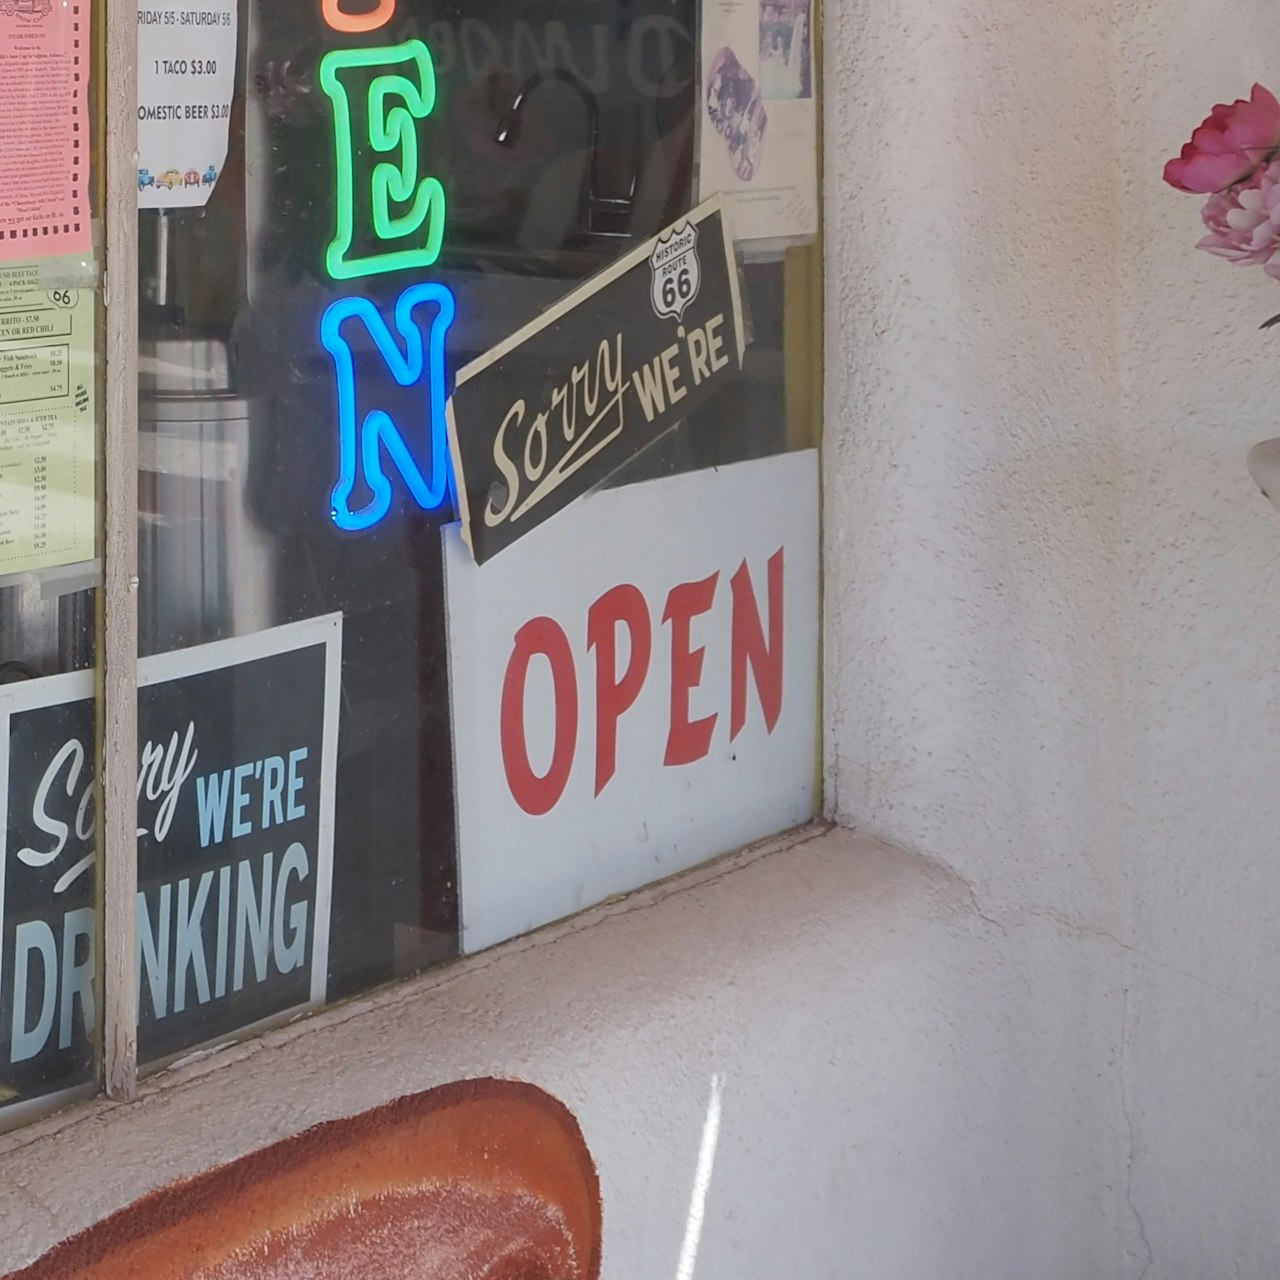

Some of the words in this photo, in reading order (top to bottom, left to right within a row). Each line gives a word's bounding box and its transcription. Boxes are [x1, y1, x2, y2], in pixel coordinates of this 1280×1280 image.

[138, 10, 162, 26] RIDAY
[181, 11, 222, 26] SATURDAY
[155, 60, 159, 74] 1
[163, 60, 187, 75] TACO
[191, 60, 217, 75] $3.00
[138, 105, 181, 121] OMESTIC
[185, 105, 208, 120] BEER
[211, 104, 229, 120] $3.00
[655, 233, 692, 265] HISTORIC
[661, 255, 688, 278] ROUTE
[53, 290, 70, 305] 66
[662, 268, 691, 308] 66
[484, 332, 630, 527] Sorry
[632, 313, 729, 423] WE'RE
[500, 545, 785, 816] OPEN
[16, 720, 199, 868] Sory
[196, 747, 309, 848] WE'RE
[10, 842, 310, 1063] DRNKING
